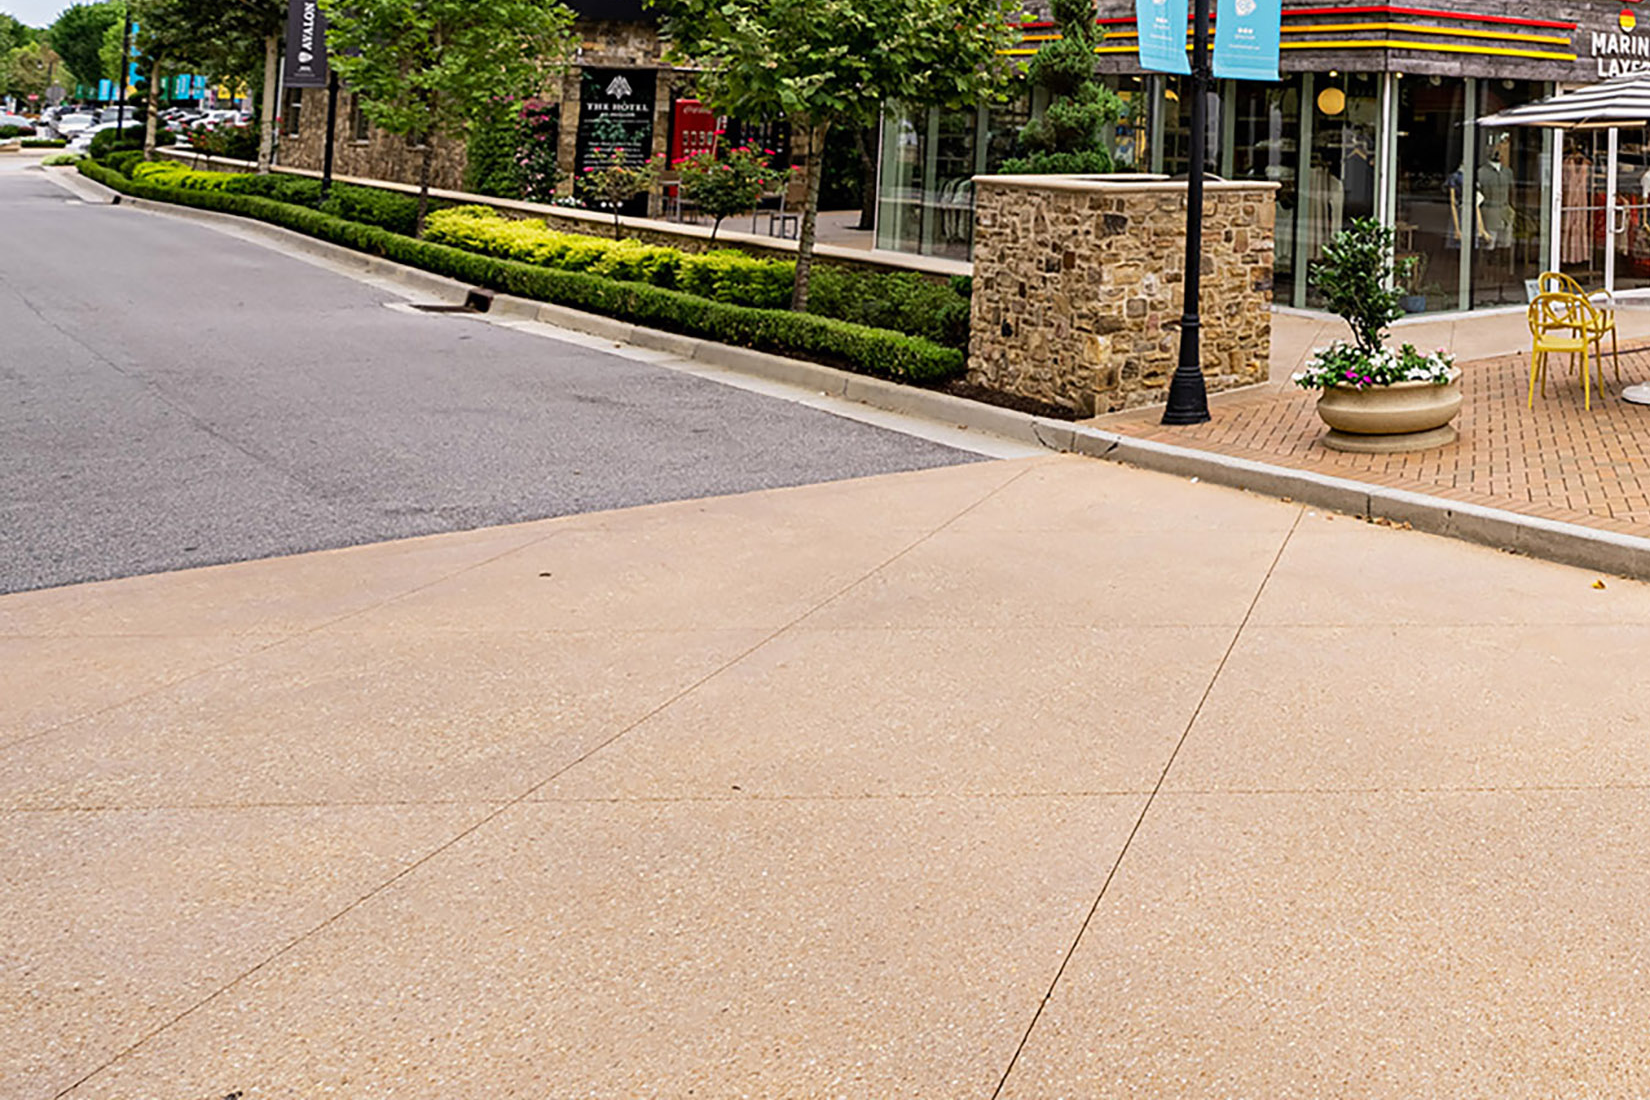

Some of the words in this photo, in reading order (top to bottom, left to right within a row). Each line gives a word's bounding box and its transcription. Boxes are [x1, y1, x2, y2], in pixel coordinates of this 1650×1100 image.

[302, 2, 315, 51] AVALON
[1597, 57, 1645, 78] LAYE
[586, 103, 609, 111] THE
